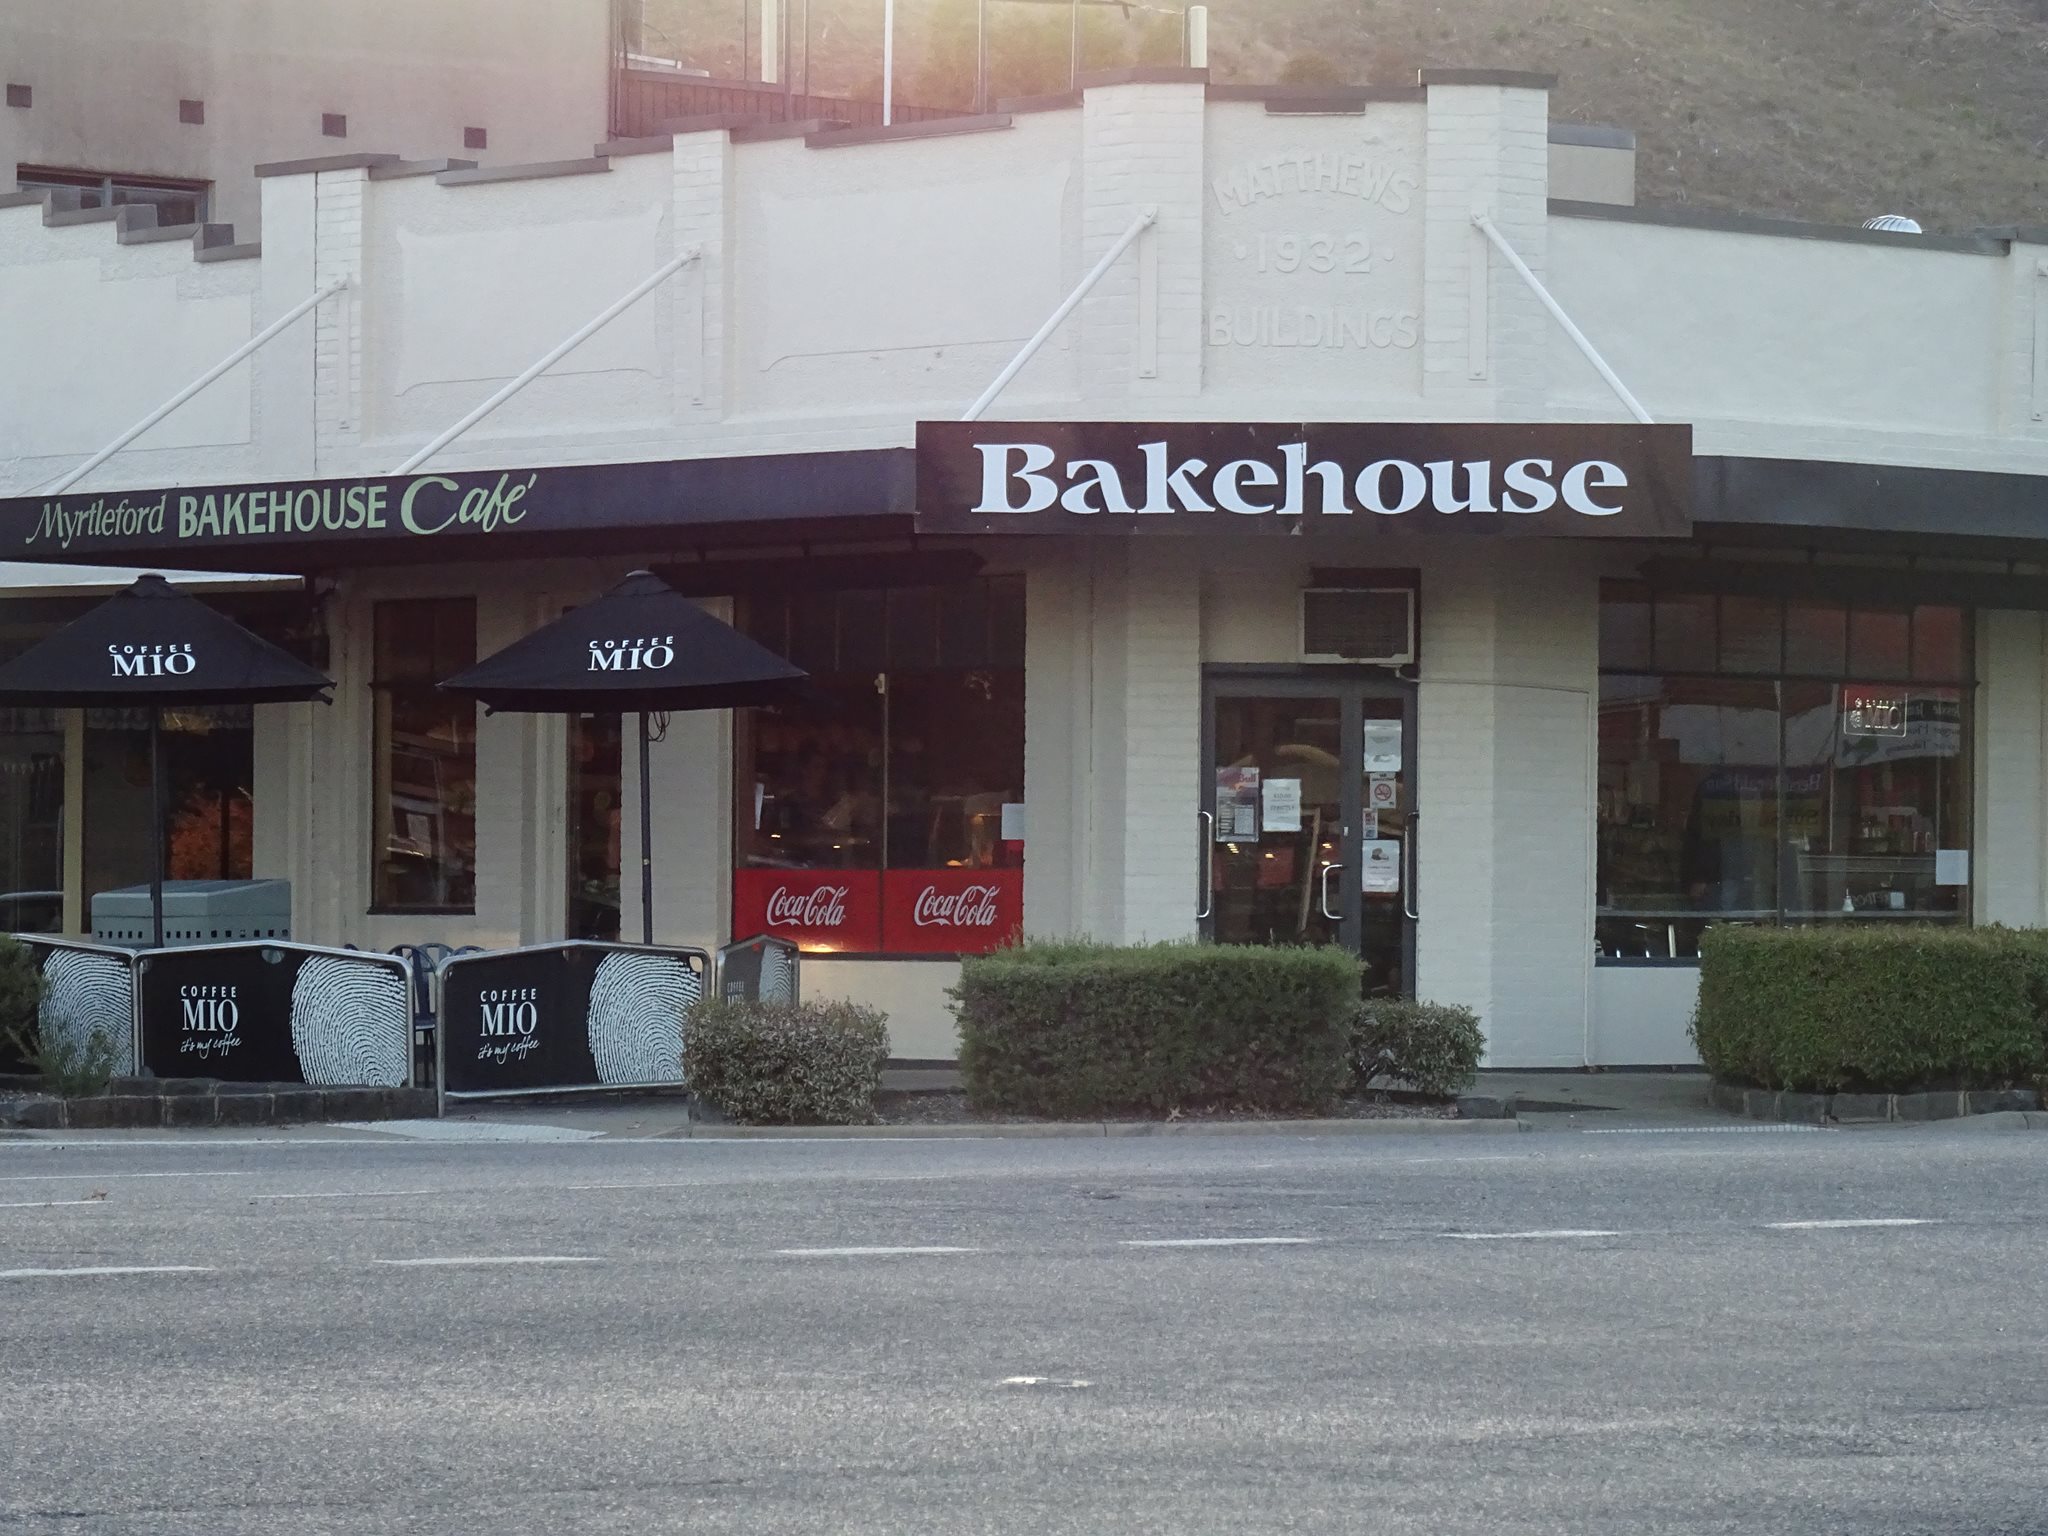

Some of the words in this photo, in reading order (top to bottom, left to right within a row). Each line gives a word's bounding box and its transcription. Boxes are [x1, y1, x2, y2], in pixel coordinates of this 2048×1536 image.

[1210, 155, 1420, 217] MATTHEWS
[1207, 303, 1420, 350] BUILDINGS
[970, 441, 1628, 516] Bakehouse
[26, 495, 165, 549] Myrtleford
[178, 485, 388, 538] BAKEHOUSE
[108, 643, 192, 655] COFFEE
[587, 645, 675, 671] MIO
[588, 635, 674, 650] COFFEE
[109, 652, 197, 677] MIO
[766, 886, 850, 926] Coca-Cola
[913, 885, 1001, 926] Coca-Cola
[180, 985, 237, 998] COFFEE
[480, 988, 537, 1002] COFFEE
[180, 998, 239, 1032] MIO
[480, 1001, 537, 1036] MIO
[196, 1039, 212, 1060] my
[213, 1032, 241, 1057] coffee
[494, 1042, 511, 1065] my
[510, 1035, 540, 1061] coffee
